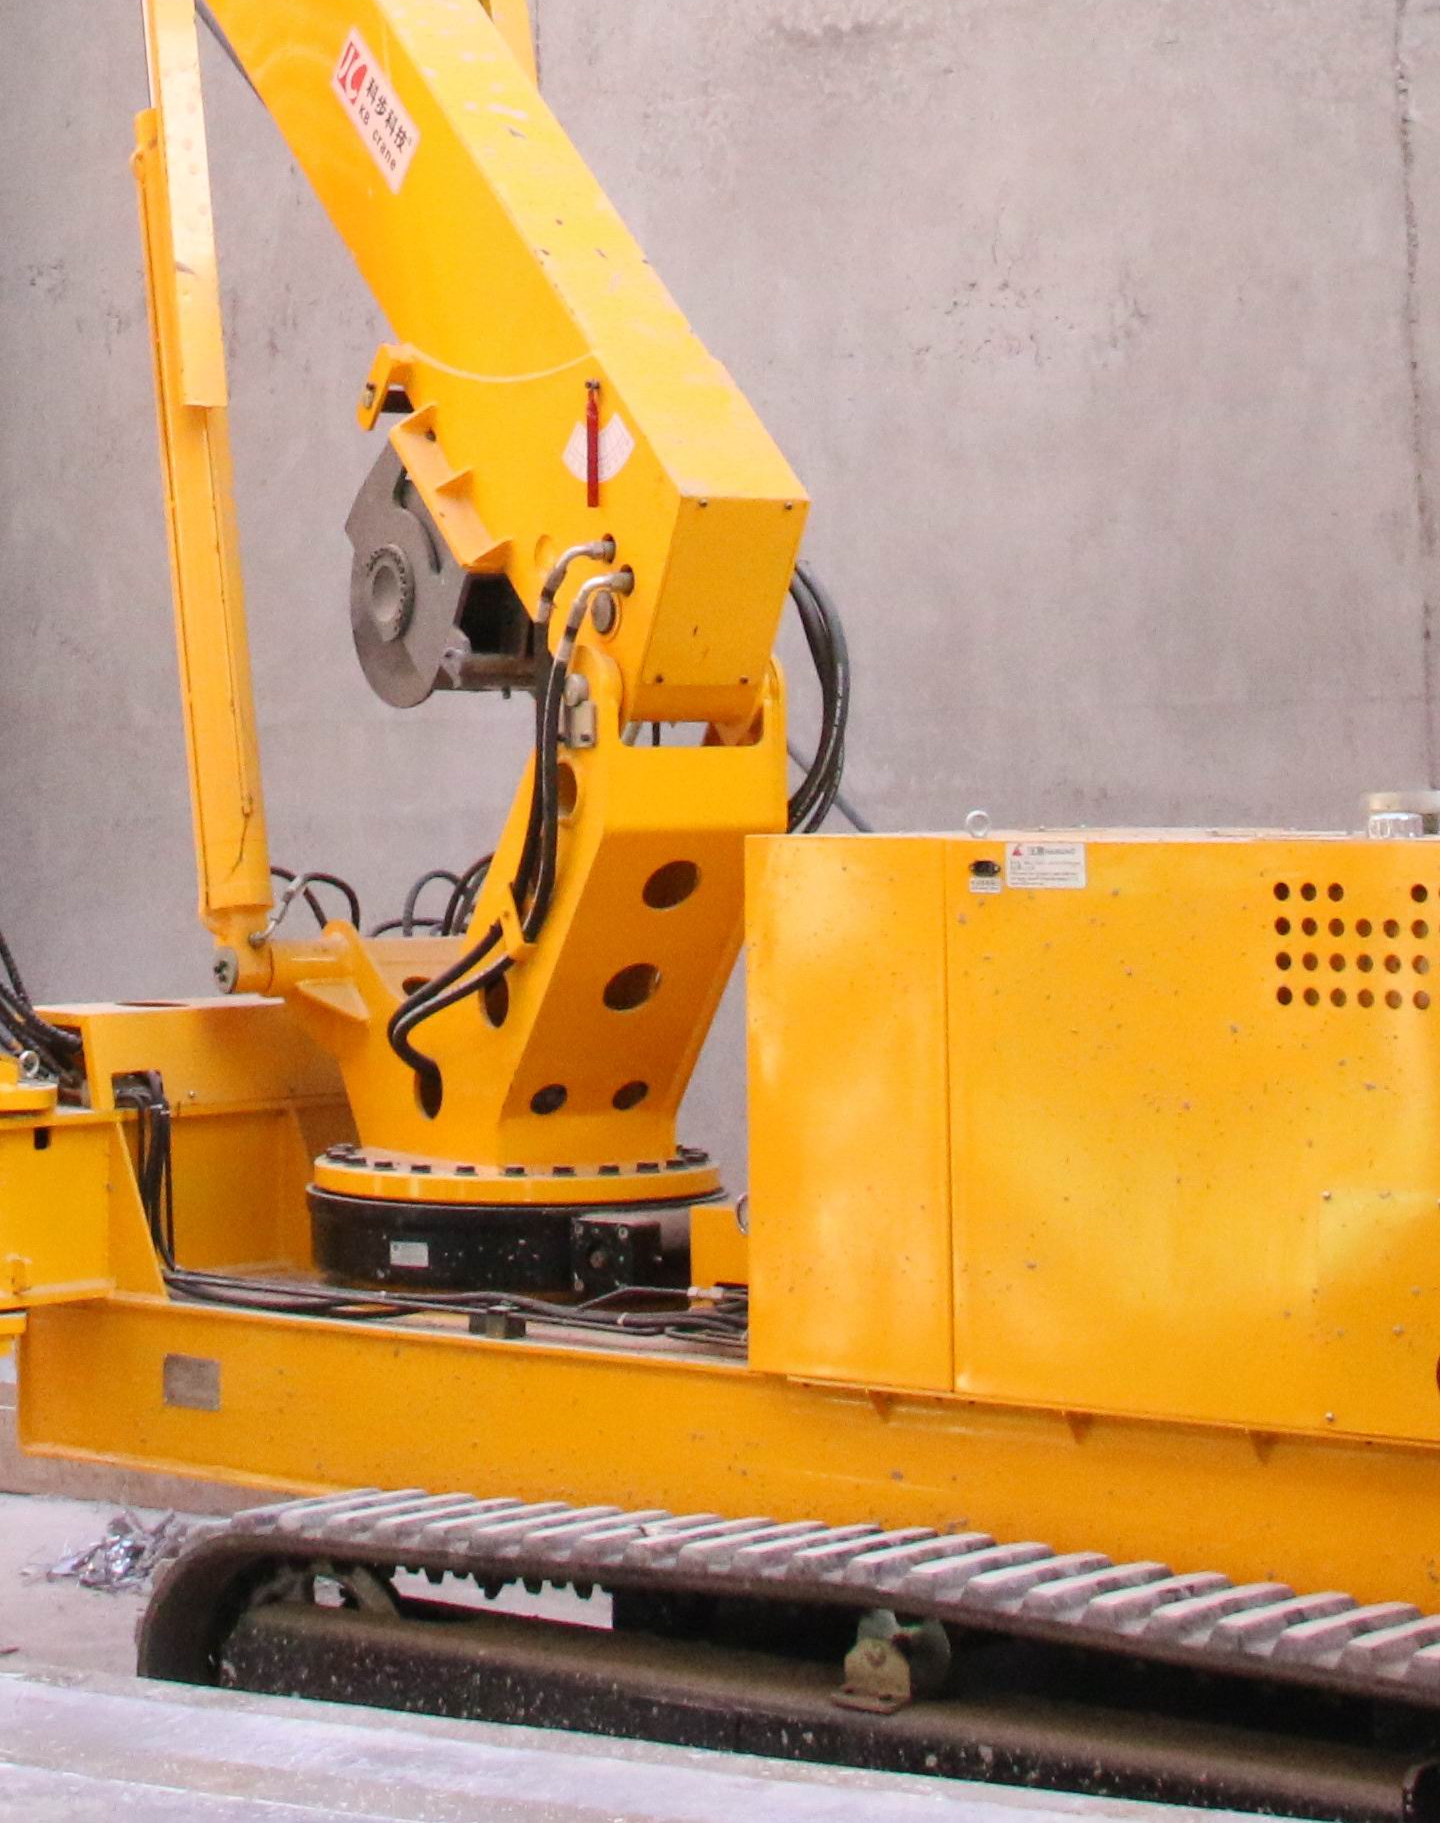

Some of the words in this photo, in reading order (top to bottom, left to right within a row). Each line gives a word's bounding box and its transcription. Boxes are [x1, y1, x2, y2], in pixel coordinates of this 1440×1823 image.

[365, 76, 408, 152] 科步科技
[372, 129, 397, 171] crane
